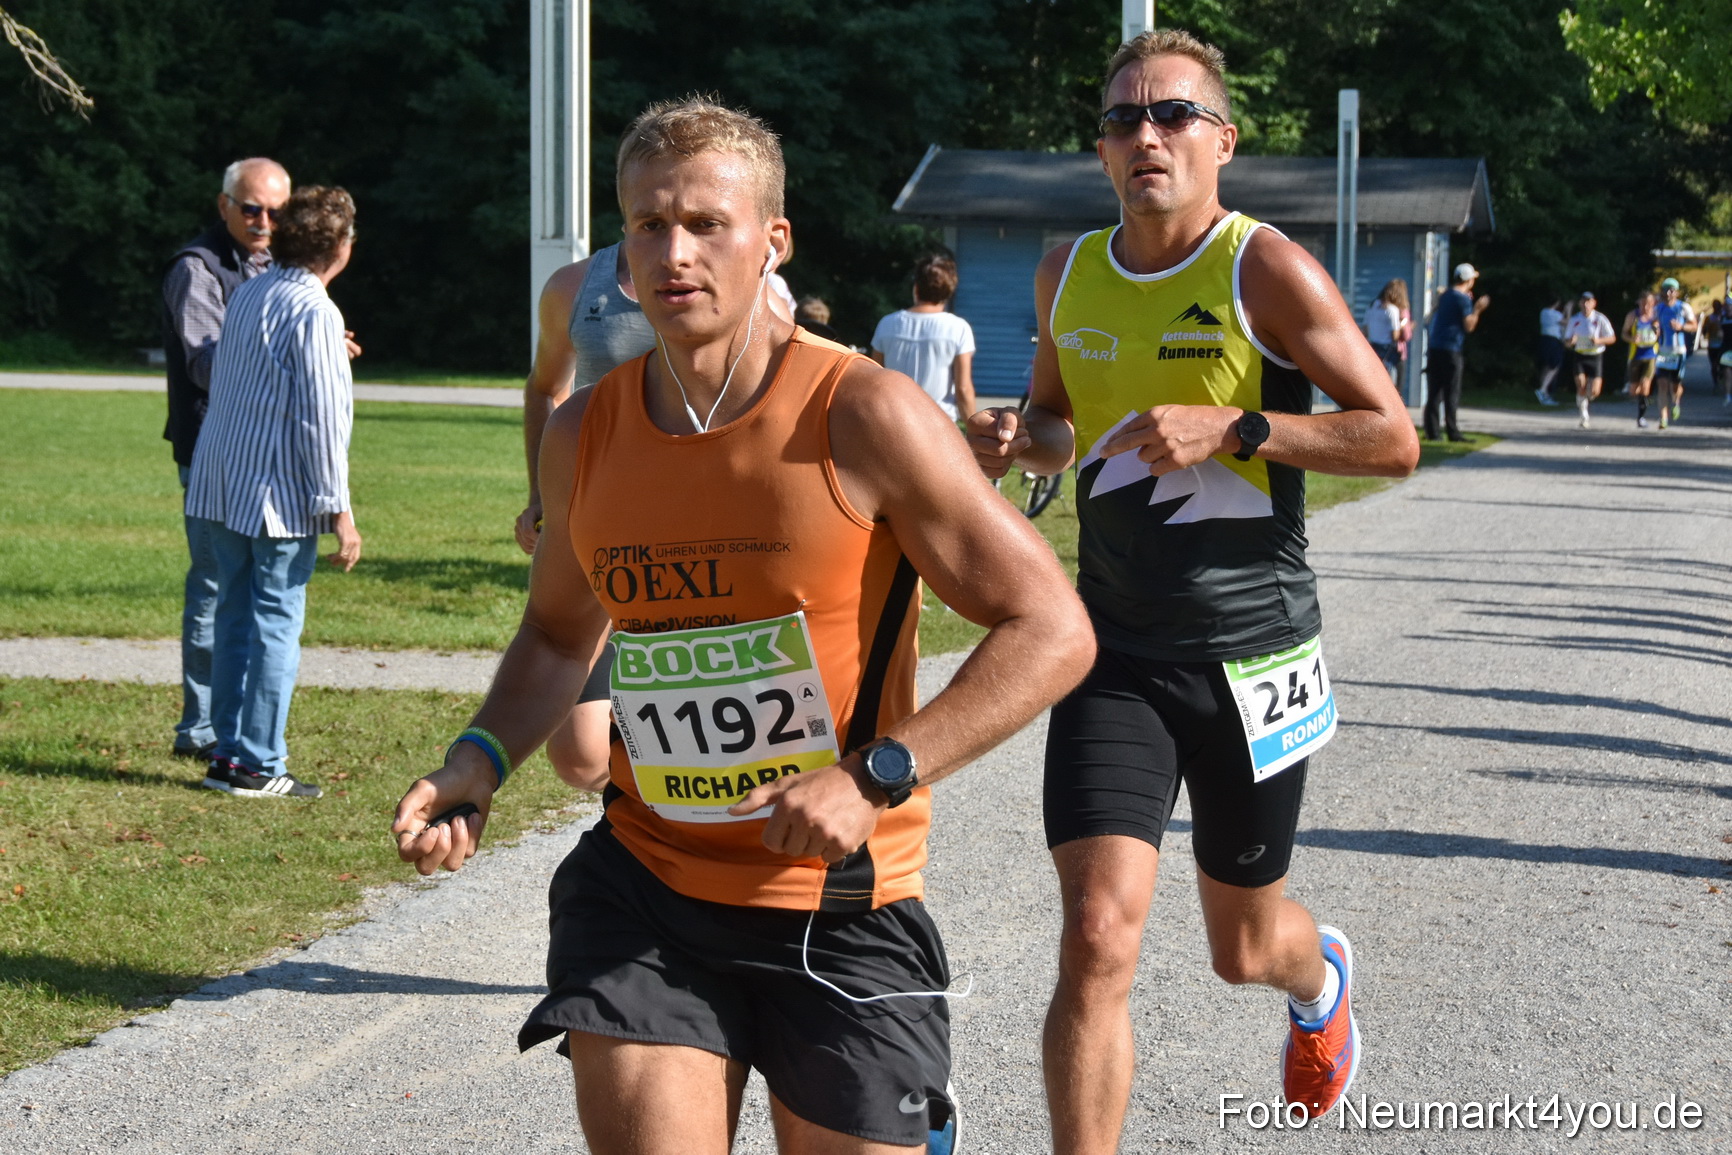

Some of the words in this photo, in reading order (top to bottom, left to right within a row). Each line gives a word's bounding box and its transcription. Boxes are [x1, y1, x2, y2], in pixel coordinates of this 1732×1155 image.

[1161, 330, 1225, 343] Kettenbach
[1079, 348, 1118, 362] MARX
[1157, 346, 1224, 361] Runners
[655, 545, 697, 558] UHREN
[700, 543, 725, 555] UND
[728, 541, 792, 554] SCHMUCK
[605, 559, 734, 604] OEXL
[618, 628, 789, 682] BOCK
[803, 686, 814, 699] A
[1252, 657, 1324, 727] 241
[636, 688, 806, 755] 1192
[1281, 701, 1333, 752] RONNY
